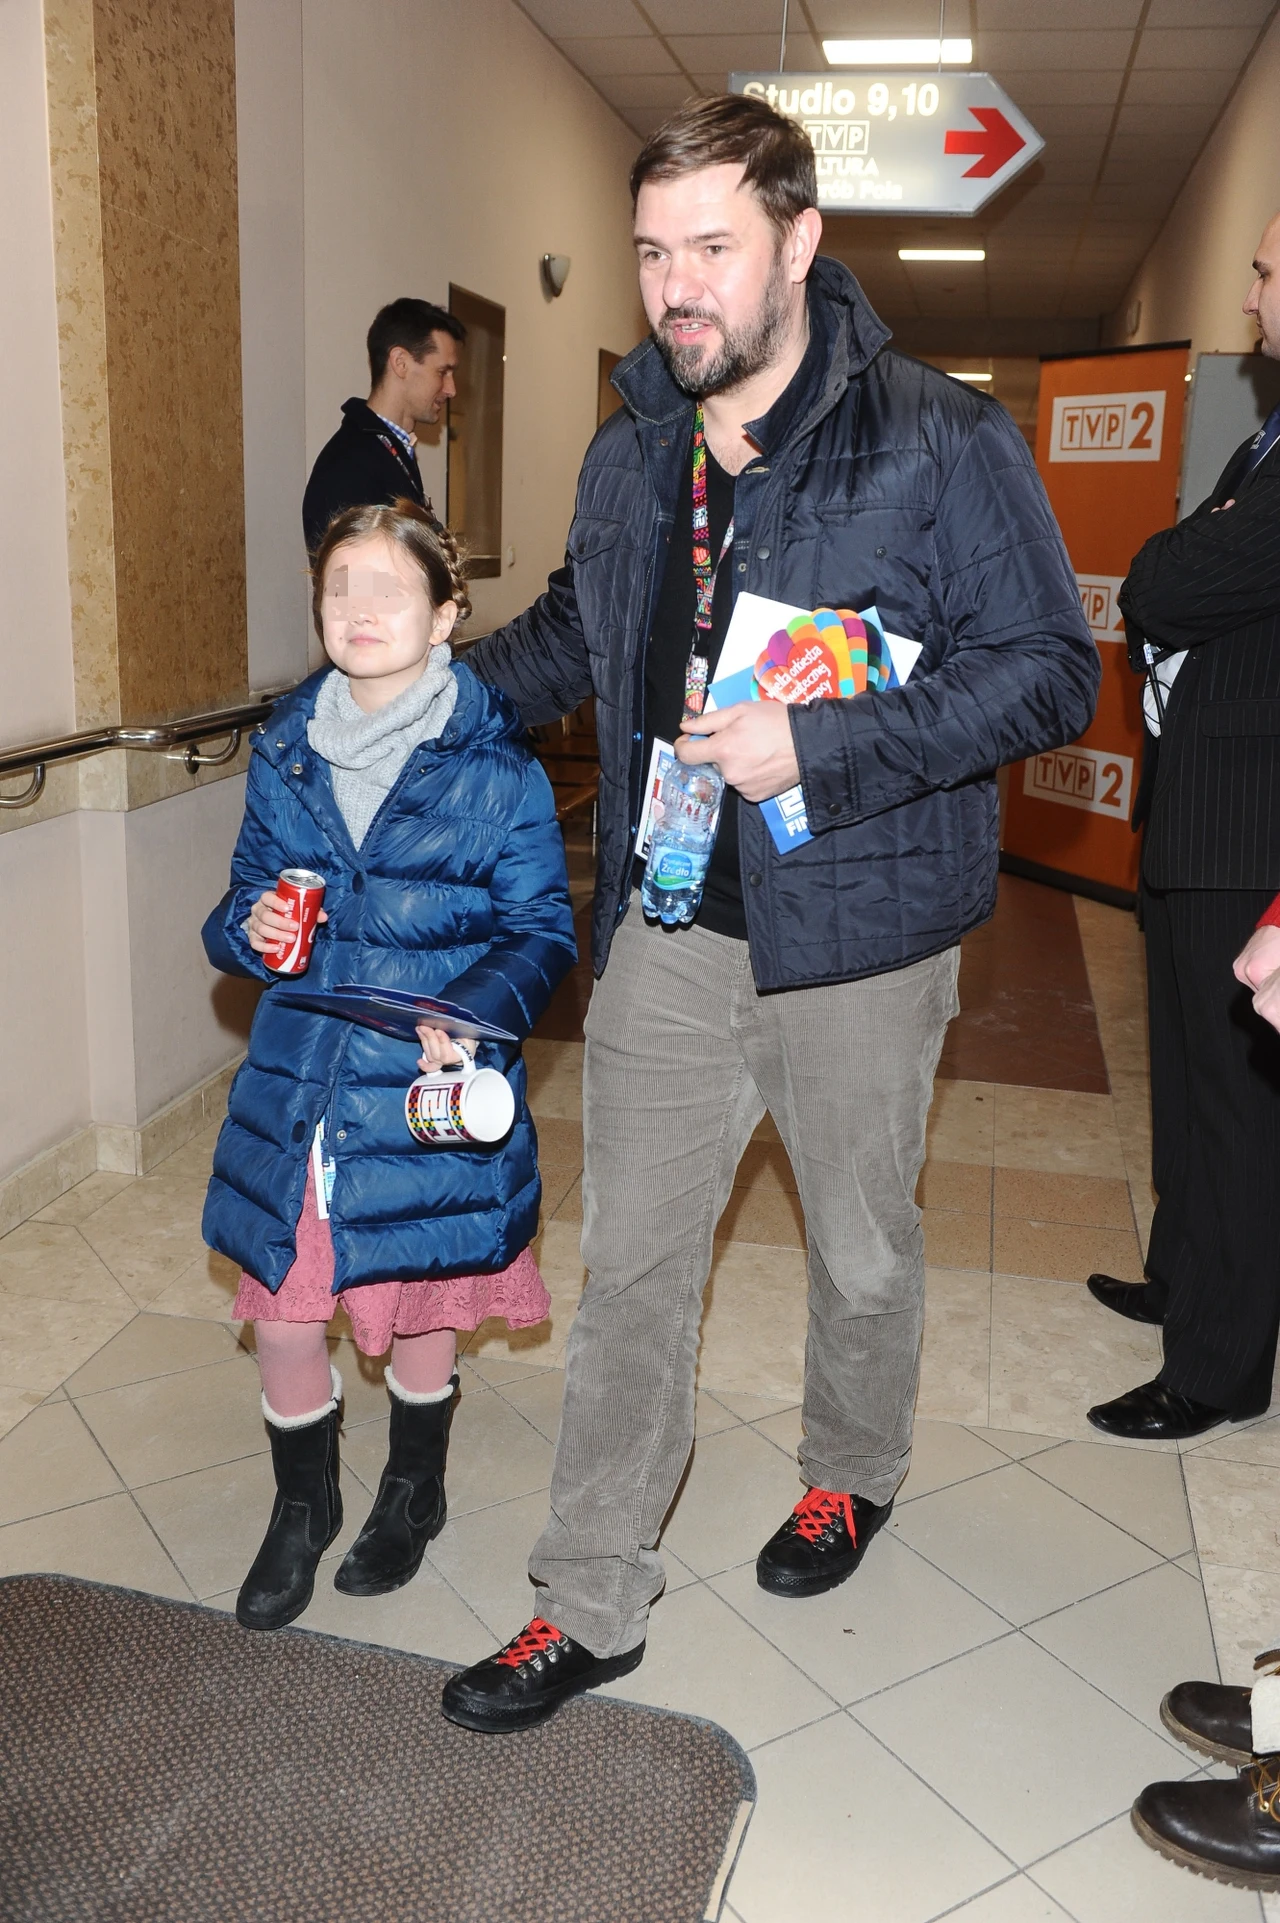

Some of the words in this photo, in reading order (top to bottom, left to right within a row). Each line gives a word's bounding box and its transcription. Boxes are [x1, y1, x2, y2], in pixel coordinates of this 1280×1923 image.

[743, 81, 856, 116] Studio
[867, 82, 940, 121] 9,10
[808, 124, 867, 150] TVP
[1064, 409, 1122, 446] TVP
[1128, 401, 1155, 450] 2
[789, 645, 824, 678] orkiestra
[1037, 754, 1093, 795] TVP
[1099, 762, 1124, 807] 2
